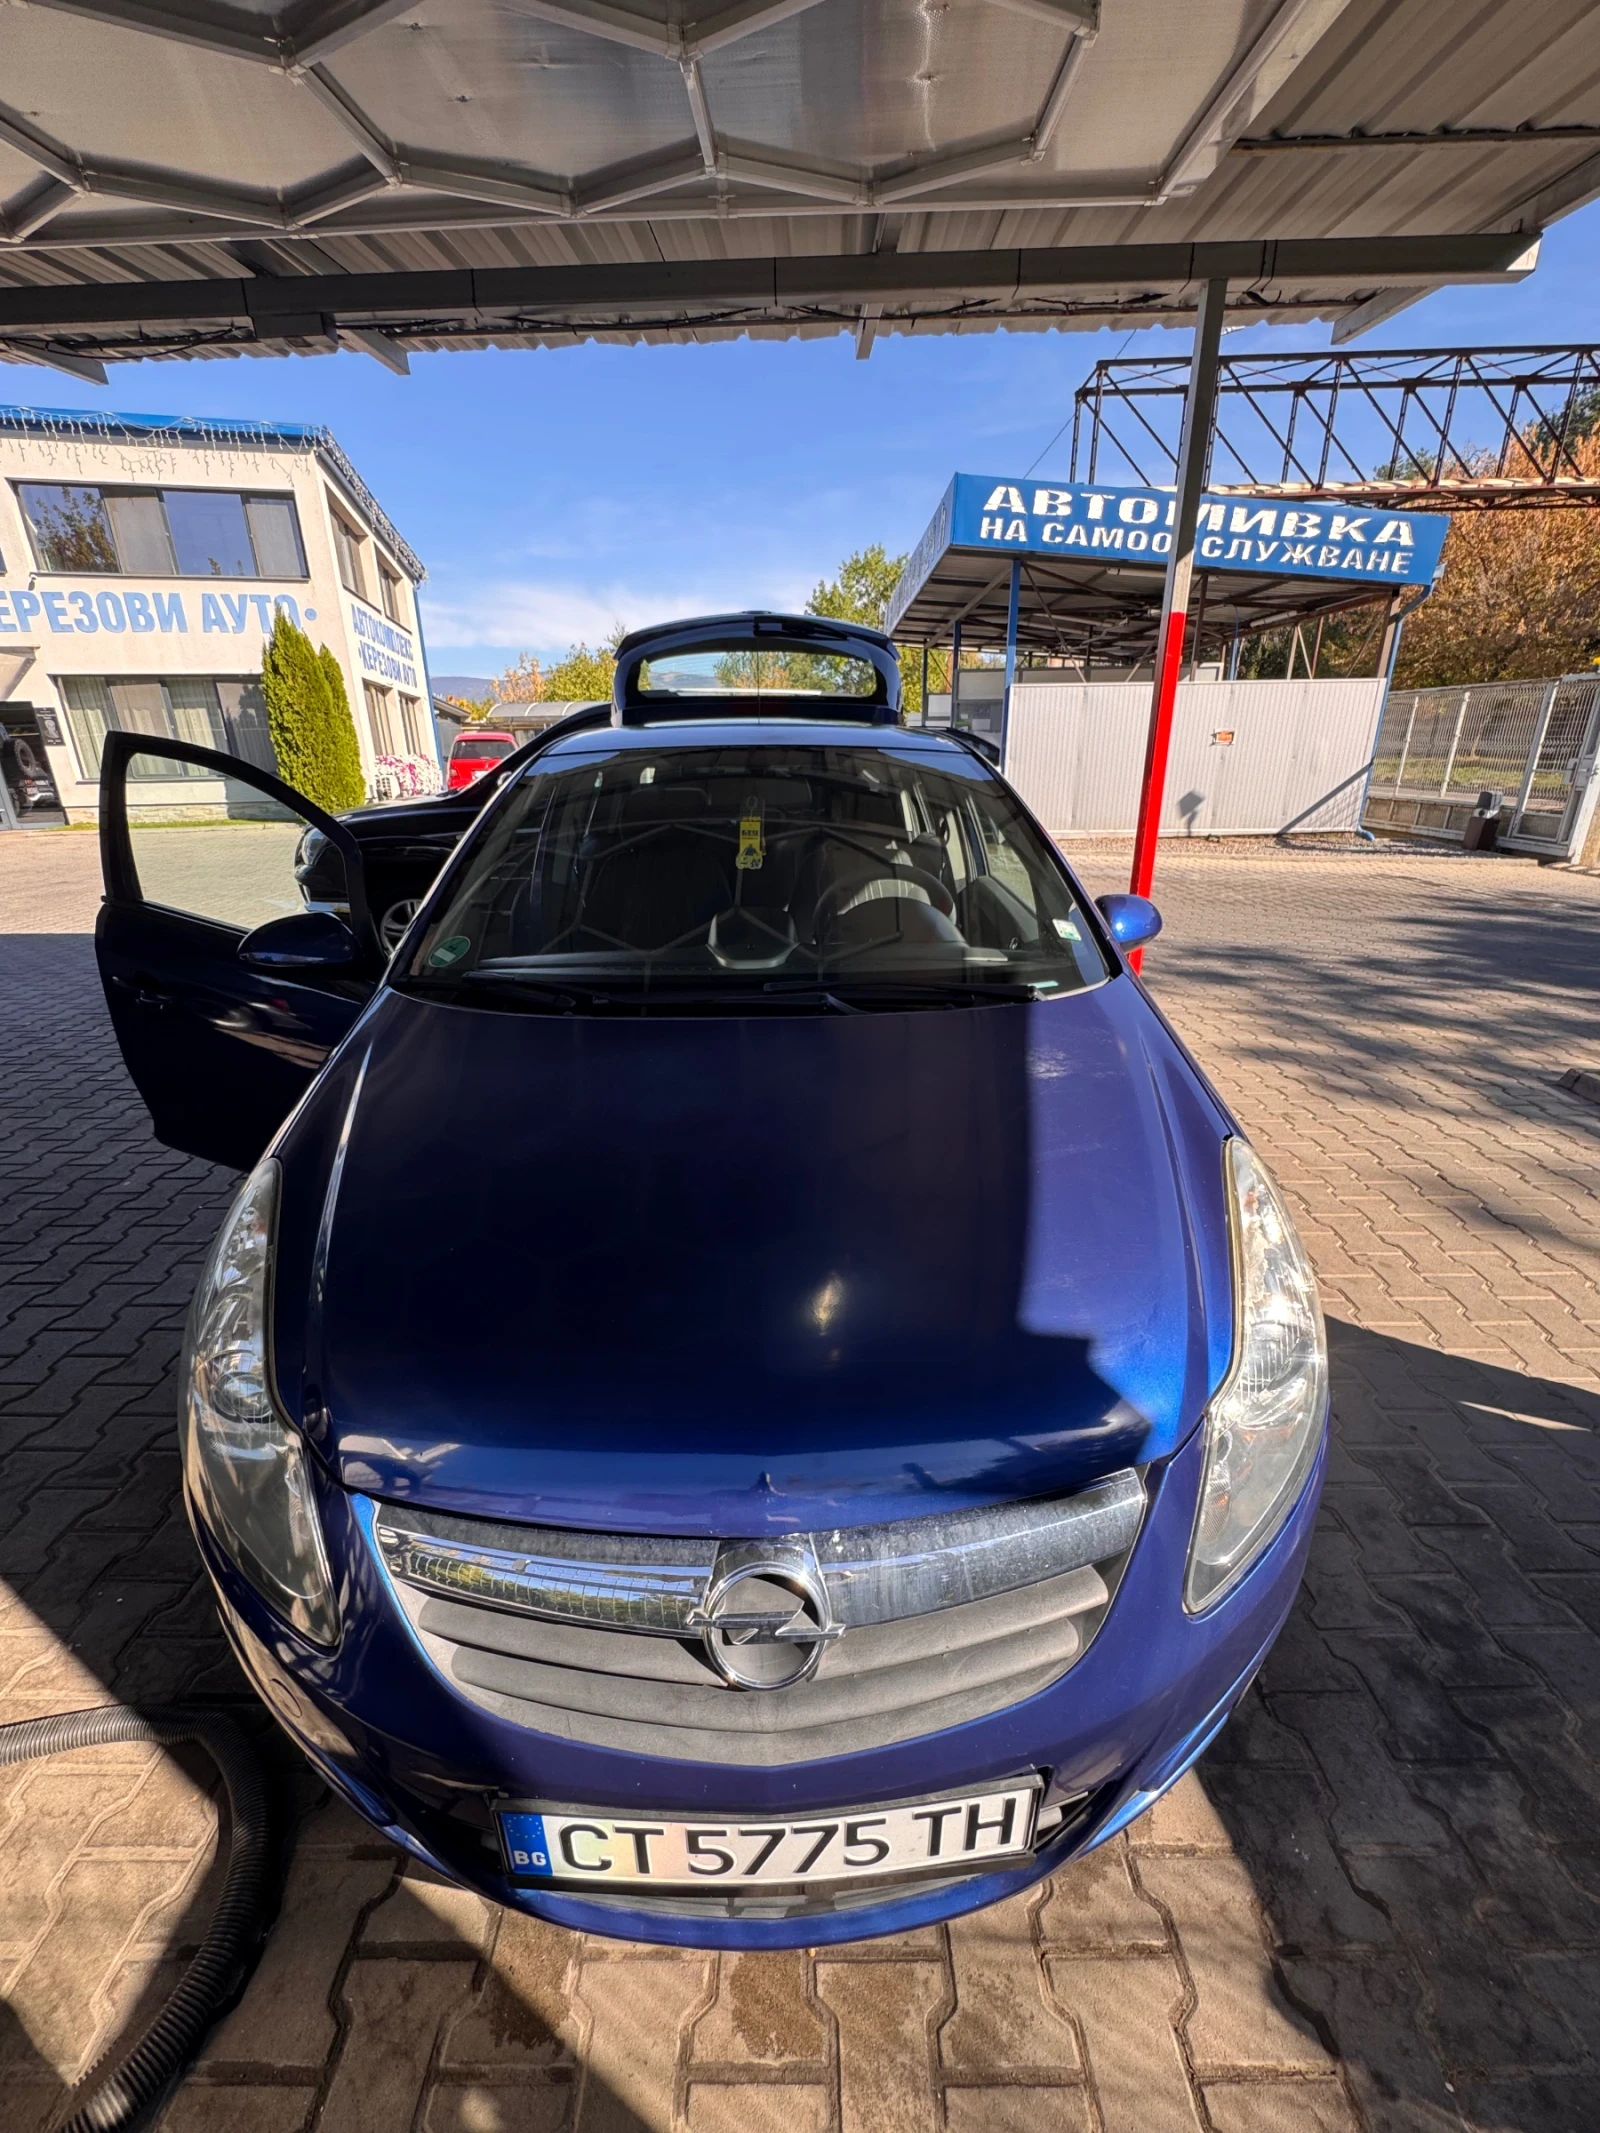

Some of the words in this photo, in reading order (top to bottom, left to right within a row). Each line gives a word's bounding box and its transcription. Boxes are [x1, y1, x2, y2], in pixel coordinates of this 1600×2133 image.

[979, 517, 1028, 543] НА
[1041, 522, 1414, 575] САМООСЛУЖВАНЕ
[202, 592, 302, 634] АУТО
[513, 1850, 547, 1866] BG
[560, 1822, 665, 1875] CT
[686, 1817, 891, 1877] 5775
[913, 1796, 1015, 1858] TH
